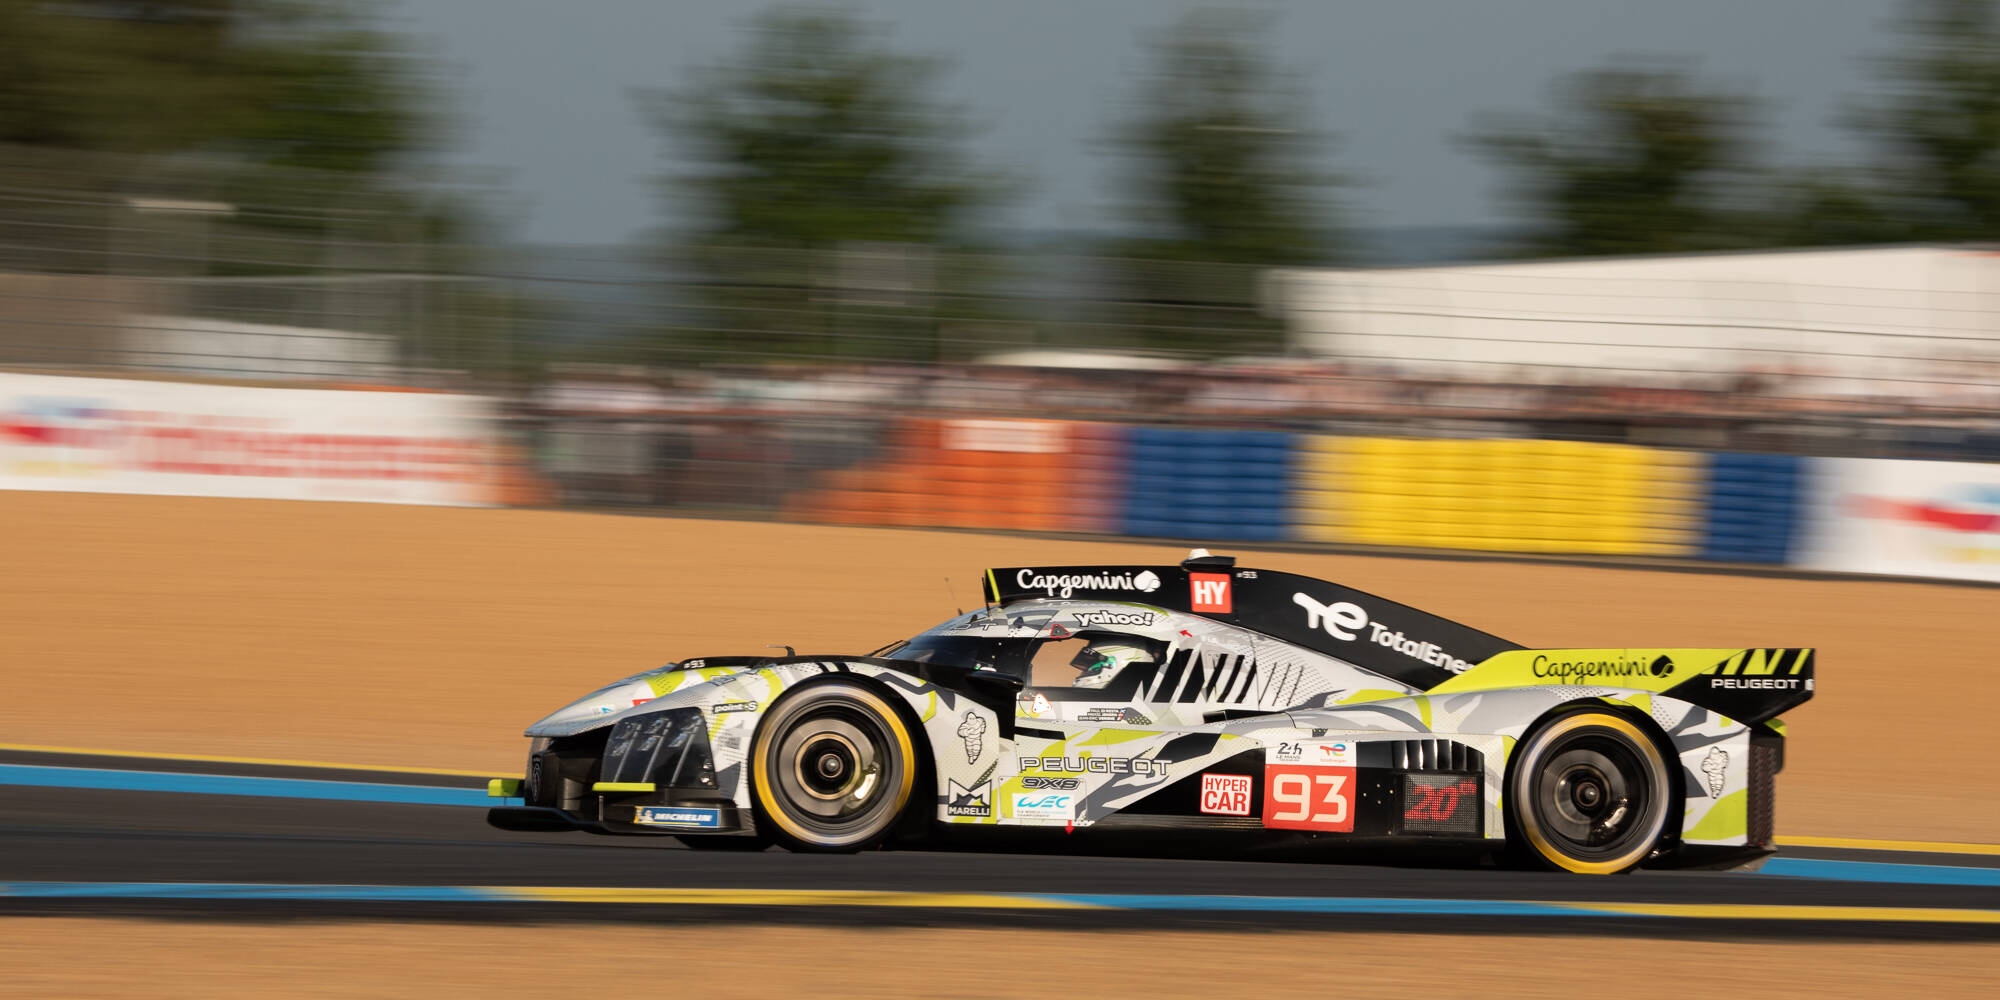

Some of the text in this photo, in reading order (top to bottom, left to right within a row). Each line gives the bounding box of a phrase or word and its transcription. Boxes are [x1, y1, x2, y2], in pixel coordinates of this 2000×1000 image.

[1016, 568, 1135, 599] Capgemini
[1192, 580, 1228, 606] HY
[1072, 610, 1154, 628] yahoo!
[1532, 655, 1648, 684] Capgemini
[1711, 679, 1800, 689] PEUGEOT
[1019, 756, 1173, 776] PEUGEOT
[1021, 776, 1081, 791] 9X8
[1204, 777, 1248, 792] HYPER
[1017, 795, 1071, 809] WEC
[1204, 790, 1247, 812] CAR
[1272, 773, 1348, 823] 93
[654, 812, 713, 822] MICHELIN
[948, 806, 990, 816] MARELLI
